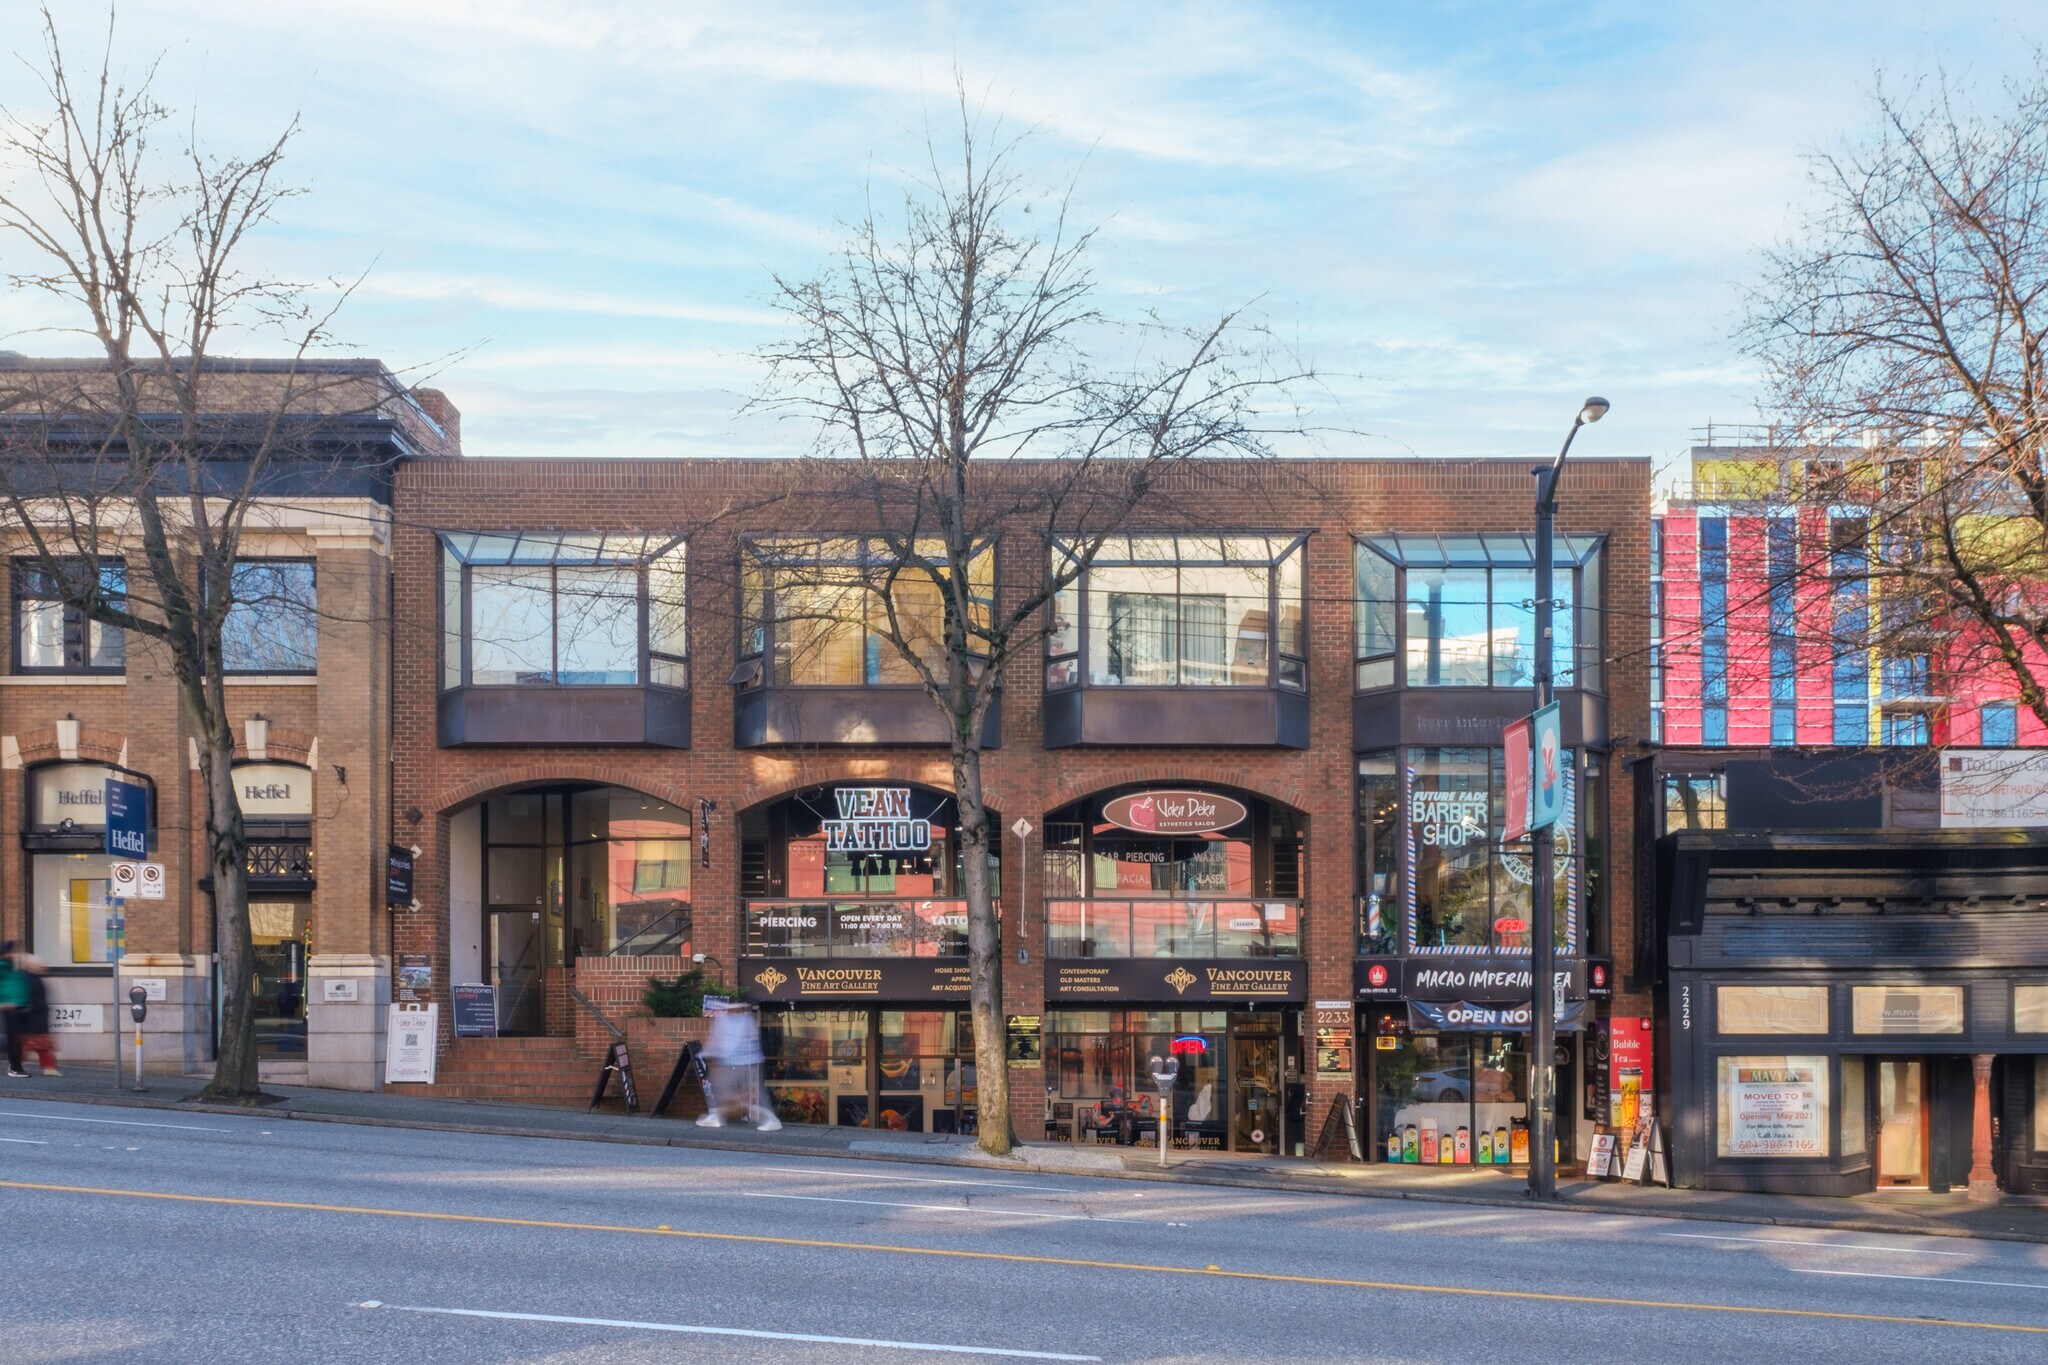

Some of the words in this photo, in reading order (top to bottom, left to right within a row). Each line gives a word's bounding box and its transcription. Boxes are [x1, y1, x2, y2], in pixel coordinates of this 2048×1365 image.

[58, 789, 102, 804] Heffel
[245, 784, 290, 799] Heffel
[1413, 792, 1456, 801] FUTURE
[1458, 792, 1488, 801] FADE
[835, 788, 910, 819] VEAN
[1157, 798, 1184, 818] Voka
[1186, 798, 1216, 818] Deka
[1412, 802, 1488, 823] BARBER
[112, 829, 144, 853] Heffel
[822, 820, 930, 851] TATTOO
[1423, 825, 1476, 846] SHOP
[1101, 852, 1119, 861] EAR
[1125, 852, 1165, 862] PIERCING
[1117, 873, 1150, 884] FACIAL
[1198, 874, 1226, 884] LASER
[760, 917, 817, 928] PIERCING
[1494, 919, 1527, 933] OPEN
[796, 967, 882, 981] VANCOUVER
[1206, 968, 1292, 981] VANCOUVER
[1416, 969, 1464, 988] MACAO
[1554, 971, 1571, 988] EA
[801, 981, 821, 990] FINE
[823, 981, 840, 990] ART
[841, 981, 878, 990] GALLERY
[1211, 982, 1231, 990] FINE
[1232, 982, 1249, 990] ART
[1251, 982, 1288, 990] GALLERY
[55, 1009, 82, 1020] 2247
[1682, 986, 1691, 1030] 2229
[1318, 1011, 1350, 1024] 2233
[1448, 1010, 1496, 1024] OPEN
[1501, 1010, 1532, 1023] NO
[1170, 1040, 1205, 1055] OPEN
[1613, 1039, 1640, 1049] Bubble
[1613, 1053, 1628, 1063] Tea
[1752, 1070, 1799, 1082] MAVYAN
[1776, 1113, 1793, 1121] May
